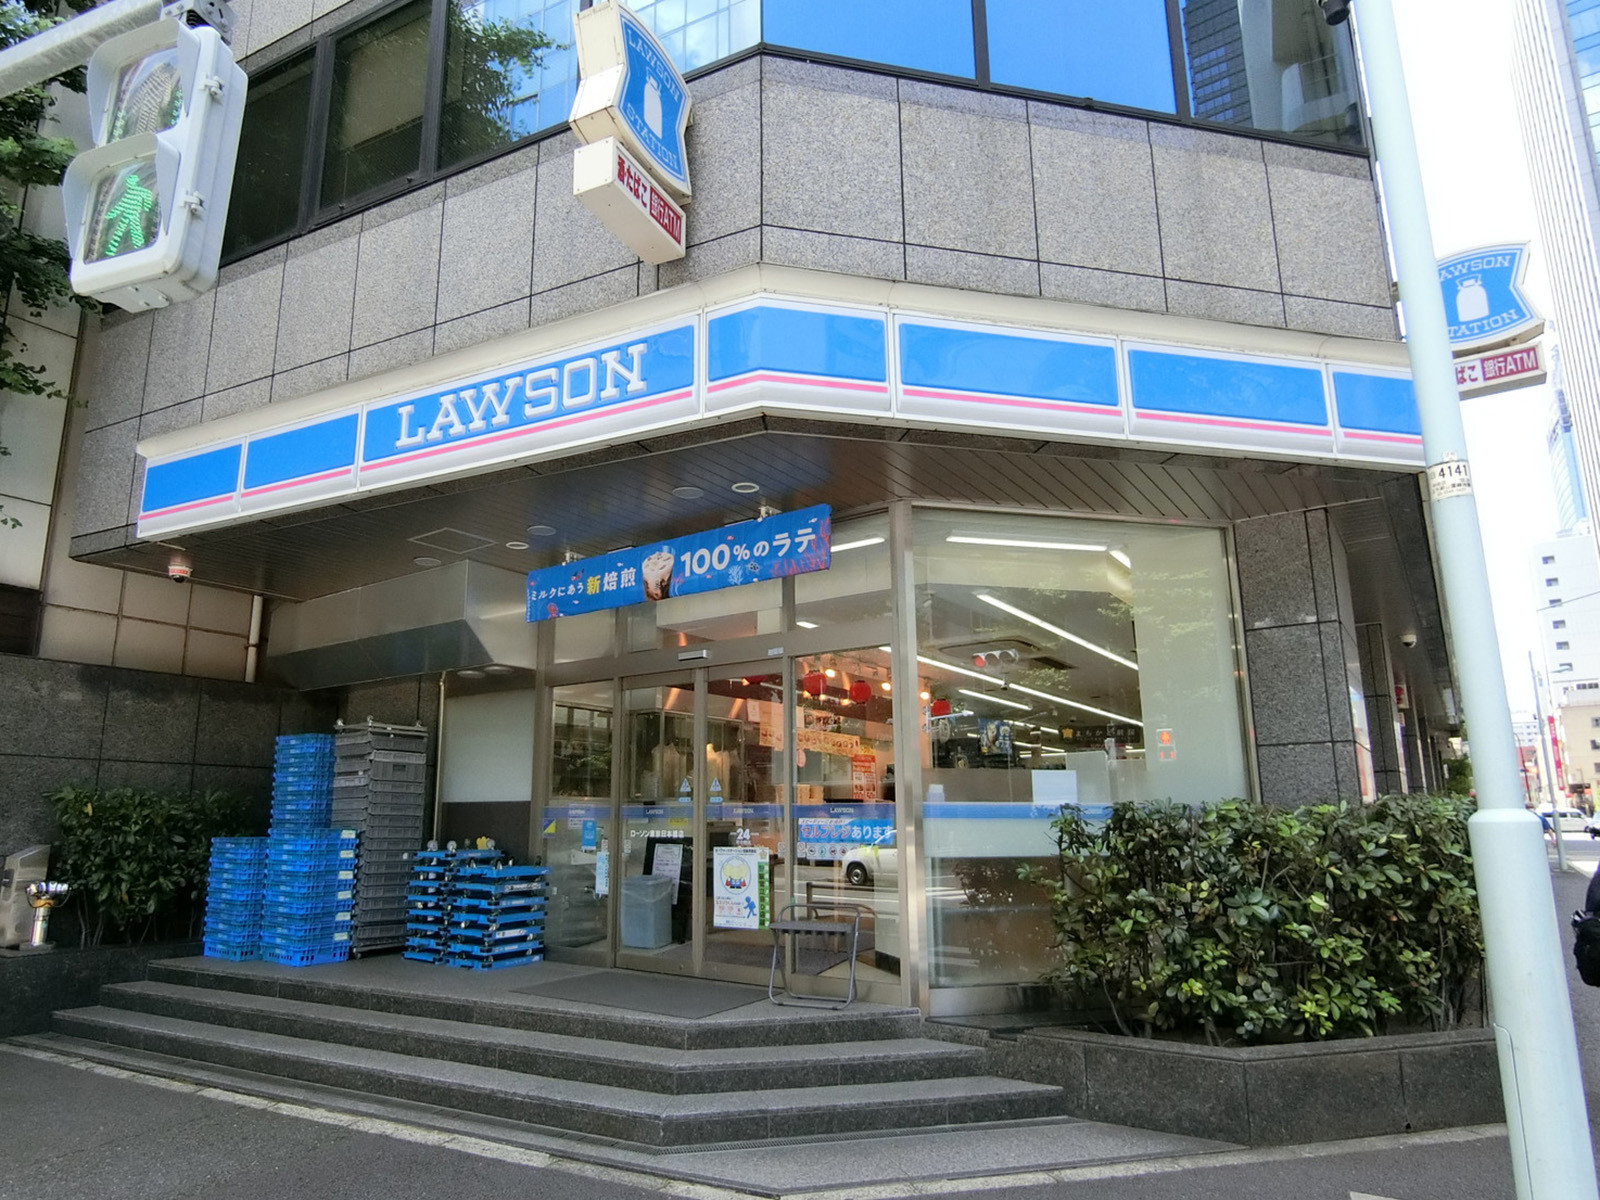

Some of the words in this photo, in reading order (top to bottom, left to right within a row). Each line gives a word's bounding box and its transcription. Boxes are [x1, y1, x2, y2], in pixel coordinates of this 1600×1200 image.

[626, 28, 681, 104] LAWSON
[626, 103, 680, 172] STATION
[1439, 255, 1512, 281] AWSON
[1448, 309, 1519, 338] TATION
[1483, 349, 1538, 379] 銀行ATM
[395, 343, 648, 449] LAWSON
[1438, 464, 1468, 479] 4141
[736, 828, 751, 840] 24
[801, 825, 895, 839] セルフレジあります
